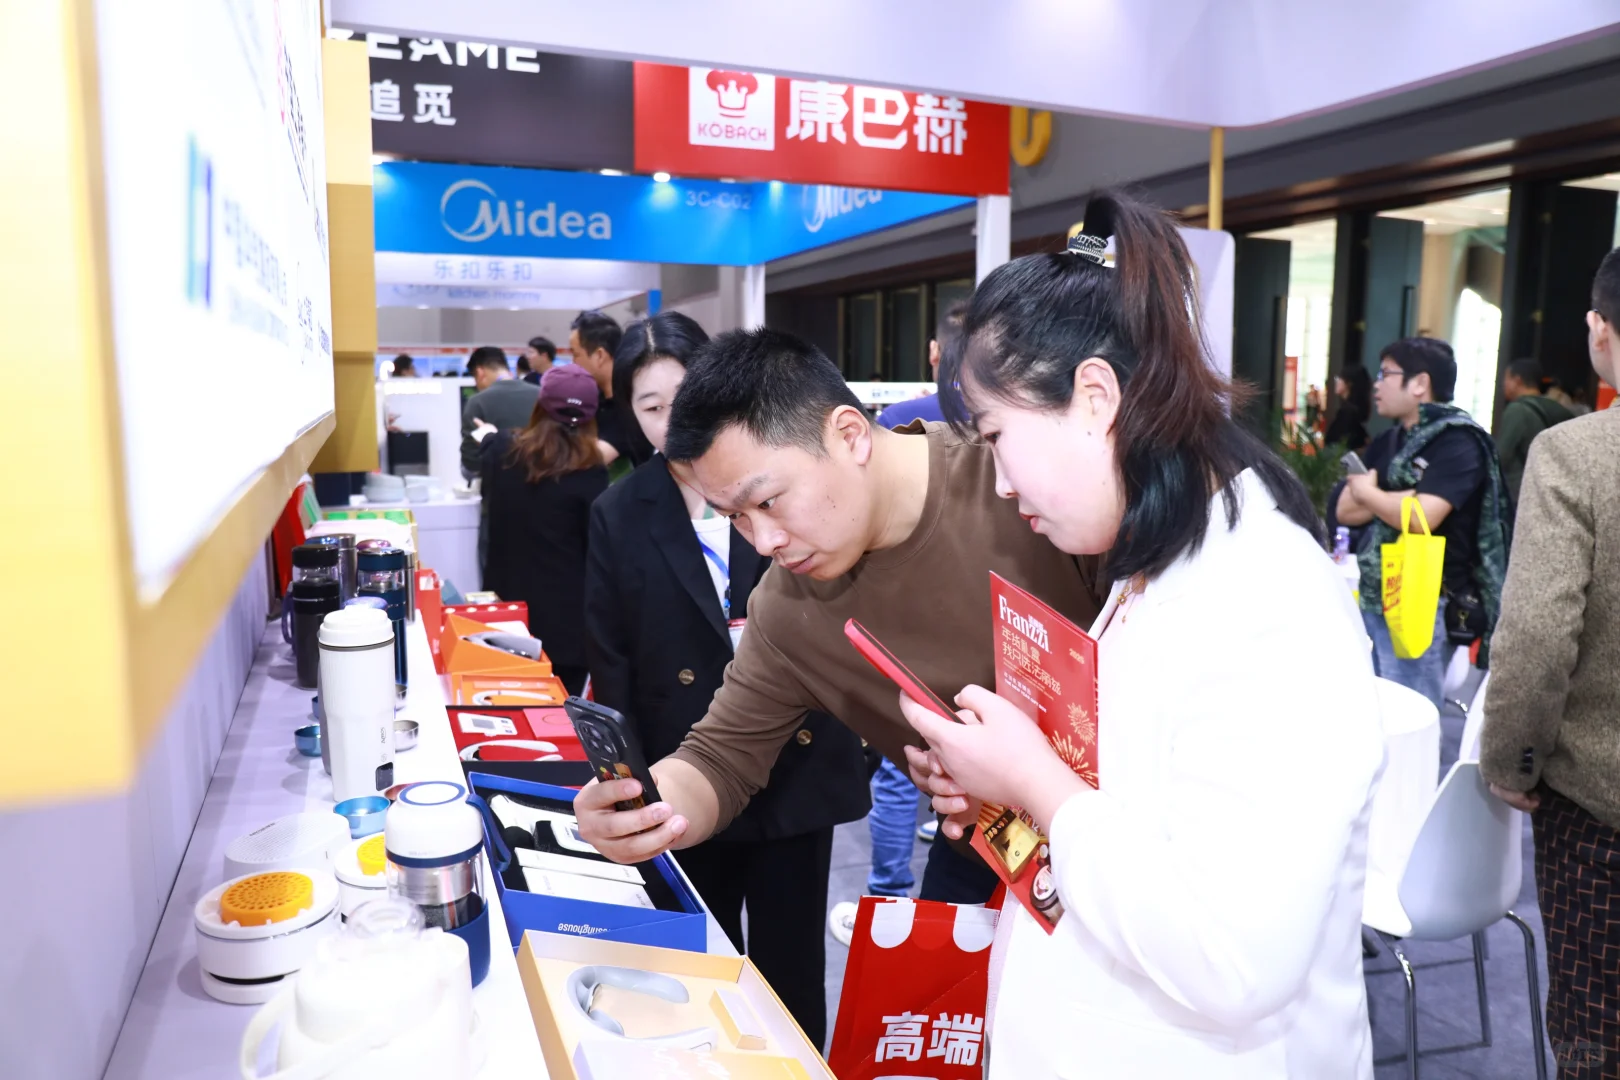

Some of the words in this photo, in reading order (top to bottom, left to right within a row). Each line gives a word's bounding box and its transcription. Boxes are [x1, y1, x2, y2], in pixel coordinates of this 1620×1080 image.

[326, 28, 541, 73] EAME
[370, 79, 457, 126] 追觅
[786, 80, 967, 156] 康巴赫
[440, 179, 612, 243] Midea
[685, 190, 751, 210] 3C-C02
[435, 260, 532, 280] 乐扣乐扣
[998, 594, 1050, 654] Franzzi
[874, 1010, 984, 1066] 高端
